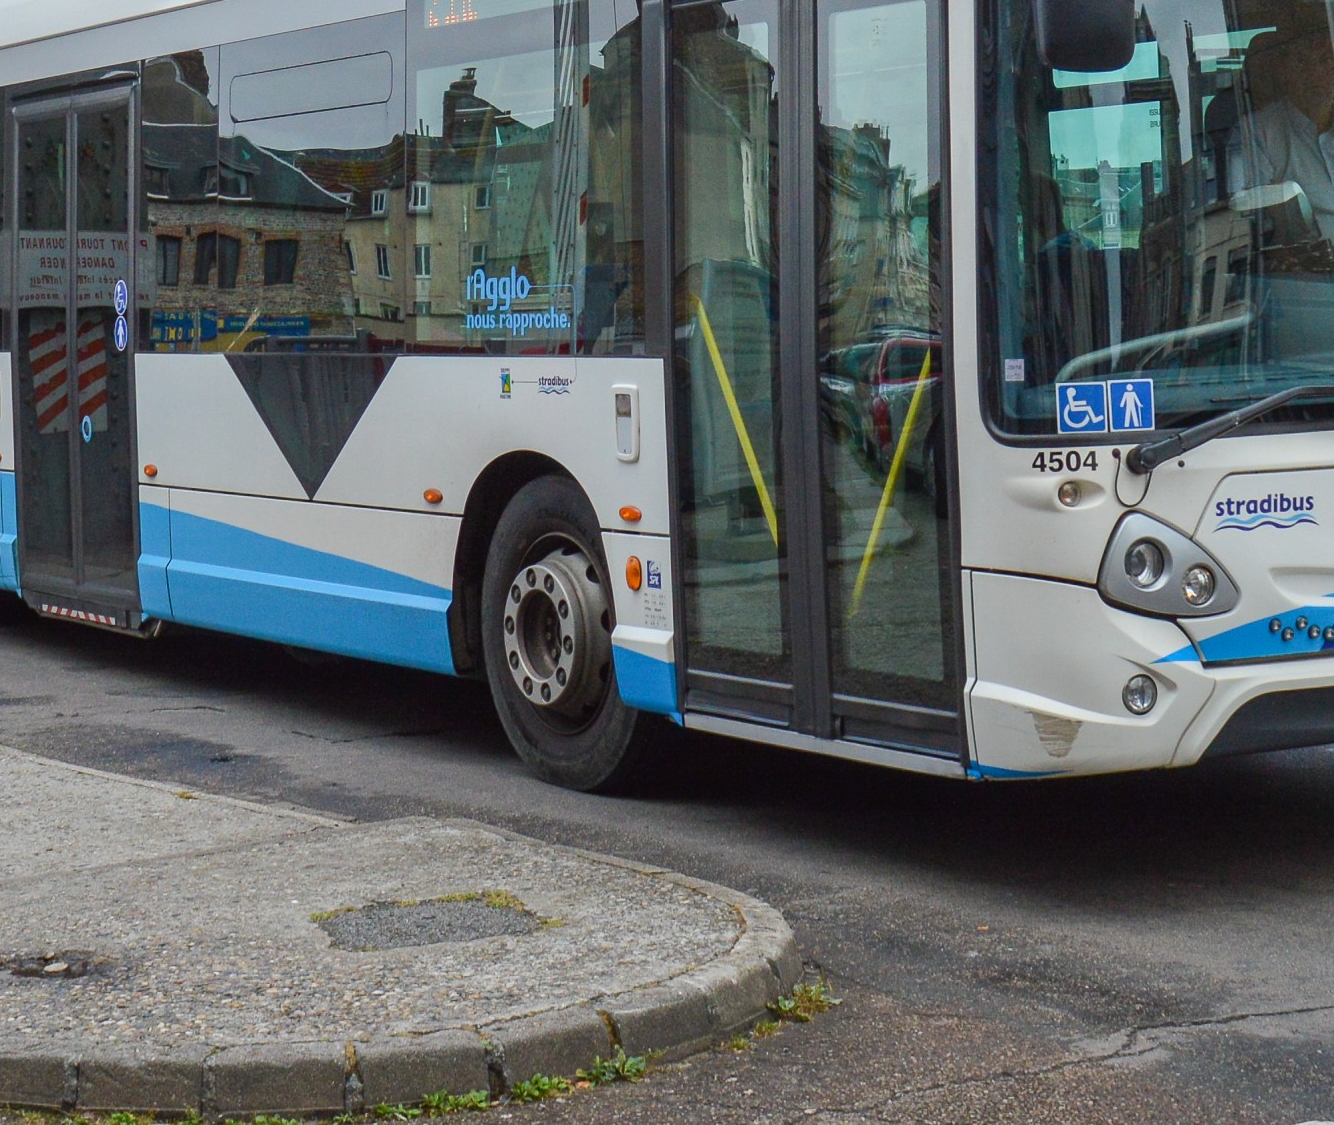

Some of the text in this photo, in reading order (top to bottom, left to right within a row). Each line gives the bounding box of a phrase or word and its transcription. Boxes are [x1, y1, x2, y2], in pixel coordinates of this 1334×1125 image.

[466, 306, 571, 335] nous rapproche.
[1031, 450, 1099, 473] 4504
[1215, 493, 1315, 517] stradibus
